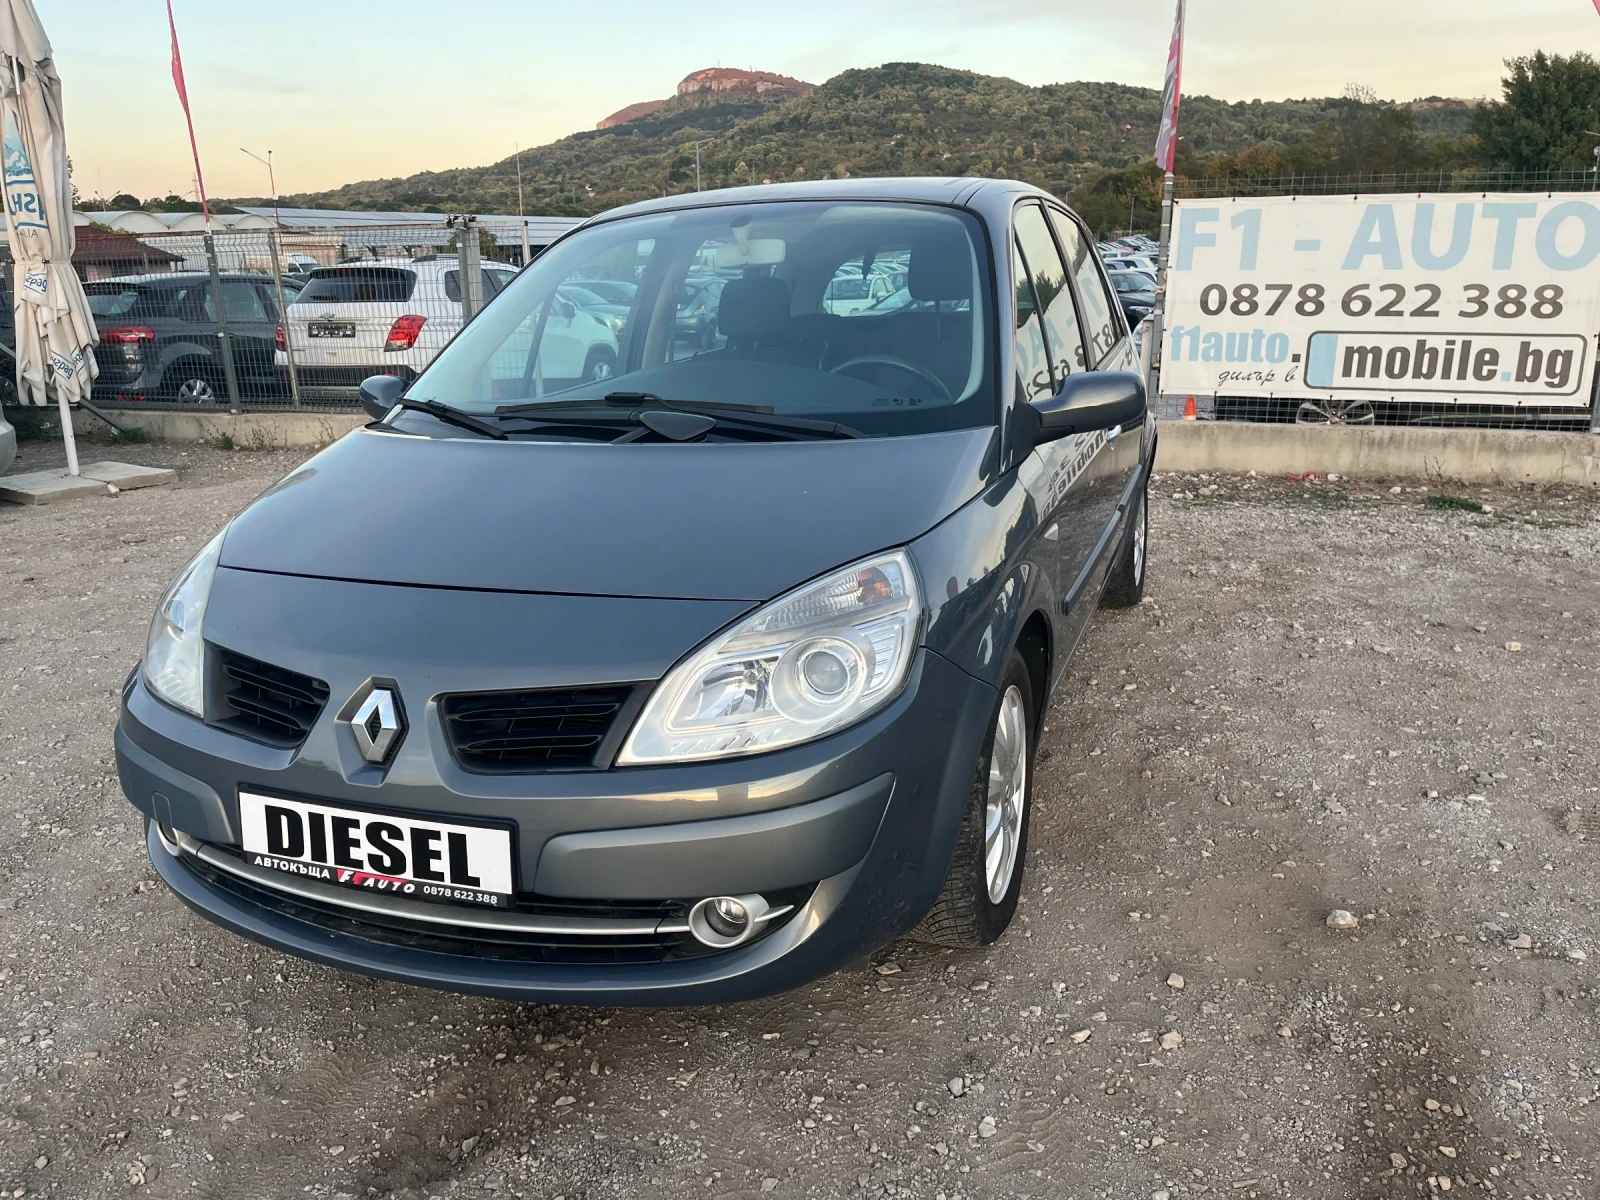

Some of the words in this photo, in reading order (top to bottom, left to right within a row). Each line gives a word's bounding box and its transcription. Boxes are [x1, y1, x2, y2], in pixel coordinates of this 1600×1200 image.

[1175, 207, 1263, 271] F1
[1340, 201, 1600, 271] AUTO
[1200, 283, 1325, 317] 0878
[1341, 283, 1442, 318] 622
[1458, 284, 1564, 319] 388
[1342, 339, 1574, 388] mobile.bg
[265, 804, 481, 888] DIESEL
[254, 855, 331, 879] АВТОКЪЩА
[364, 877, 416, 893] AUTO
[423, 885, 451, 897] 0878
[454, 890, 474, 901] 622
[476, 893, 497, 905] 388
